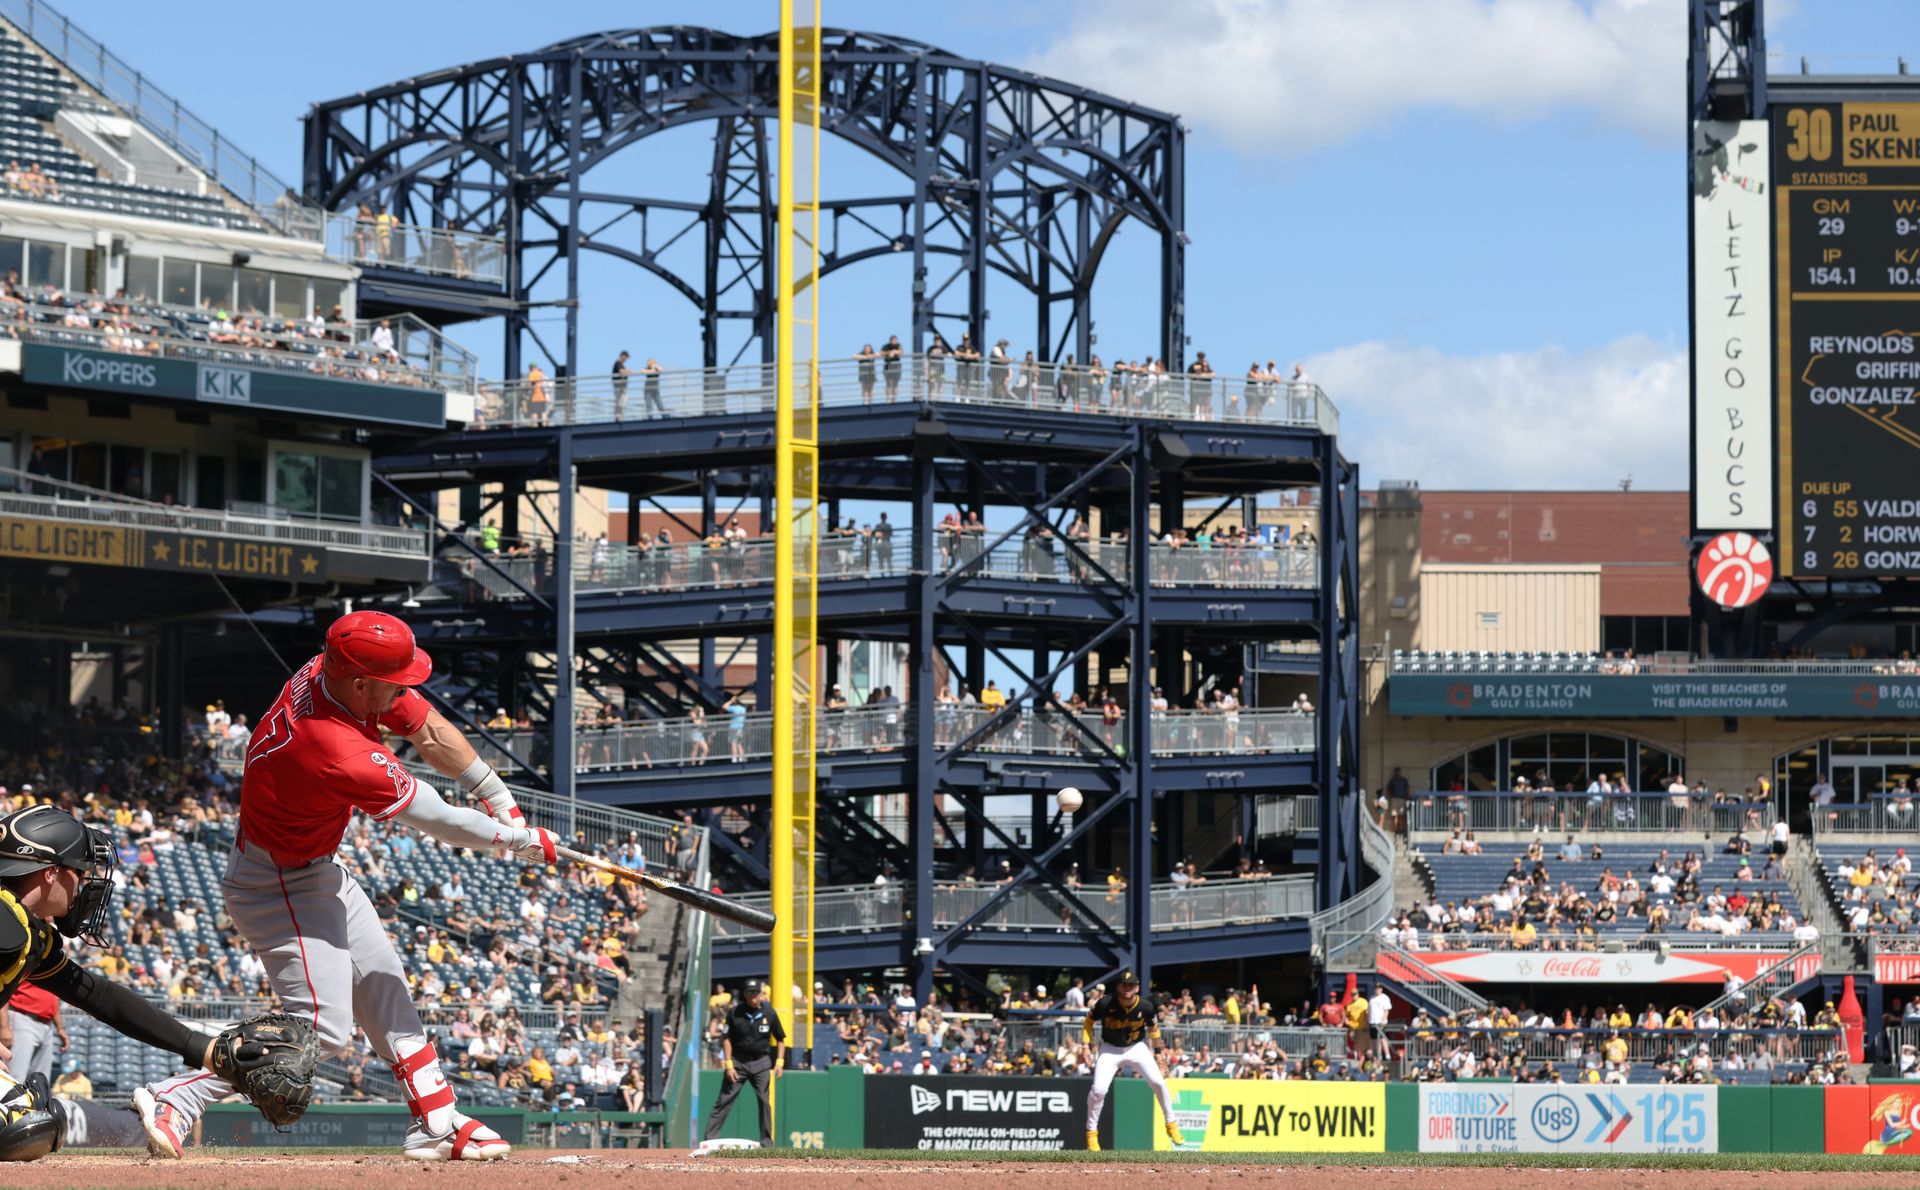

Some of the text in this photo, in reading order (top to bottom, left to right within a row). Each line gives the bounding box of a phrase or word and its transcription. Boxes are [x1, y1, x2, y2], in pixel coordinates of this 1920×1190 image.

[1786, 108, 1899, 161] 30 PAUL
[1791, 172, 1868, 185] STATISTICS
[1812, 198, 1850, 214] GM
[1818, 217, 1845, 236] 29
[1725, 209, 1746, 317] LETZ
[1823, 248, 1842, 264] IP
[1808, 266, 1856, 286] 154.1
[1809, 335, 1914, 354] REYNOLDS
[63, 351, 157, 388] KOPPERS
[1725, 337, 1745, 389] GO
[1809, 386, 1916, 405] GONZALEZ
[1726, 407, 1746, 516] BUCS
[1802, 482, 1851, 495] DUE UP
[1802, 500, 1818, 518] 6
[1833, 500, 1859, 518] 55
[36, 525, 115, 559] LIGHT
[1803, 525, 1817, 543] 7
[1839, 525, 1852, 543] 2
[178, 537, 294, 576] I.C. LIGHT
[1803, 550, 1818, 569] 8
[1833, 550, 1859, 569] 26
[1472, 684, 1592, 698] BRADENTON
[1652, 683, 1787, 694] VISIT THE BEACHES OF
[1491, 699, 1574, 708] GULF ISLANDS
[1652, 698, 1788, 708] THE BRADENTON AREA
[1543, 956, 1601, 977] Coca-Cola
[1428, 1092, 1487, 1115] FORGING
[1220, 1104, 1375, 1137] PLAY TO WIN!
[1539, 1106, 1573, 1130] USS
[1636, 1093, 1706, 1143] 125
[923, 1127, 1060, 1139] THE OFFICIAL ON-FIELD CAP
[1428, 1117, 1518, 1140] OUR FUTURE
[918, 1139, 933, 1150] OF
[934, 1139, 970, 1150] MAJOR
[971, 1140, 1010, 1150] LEAGUE
